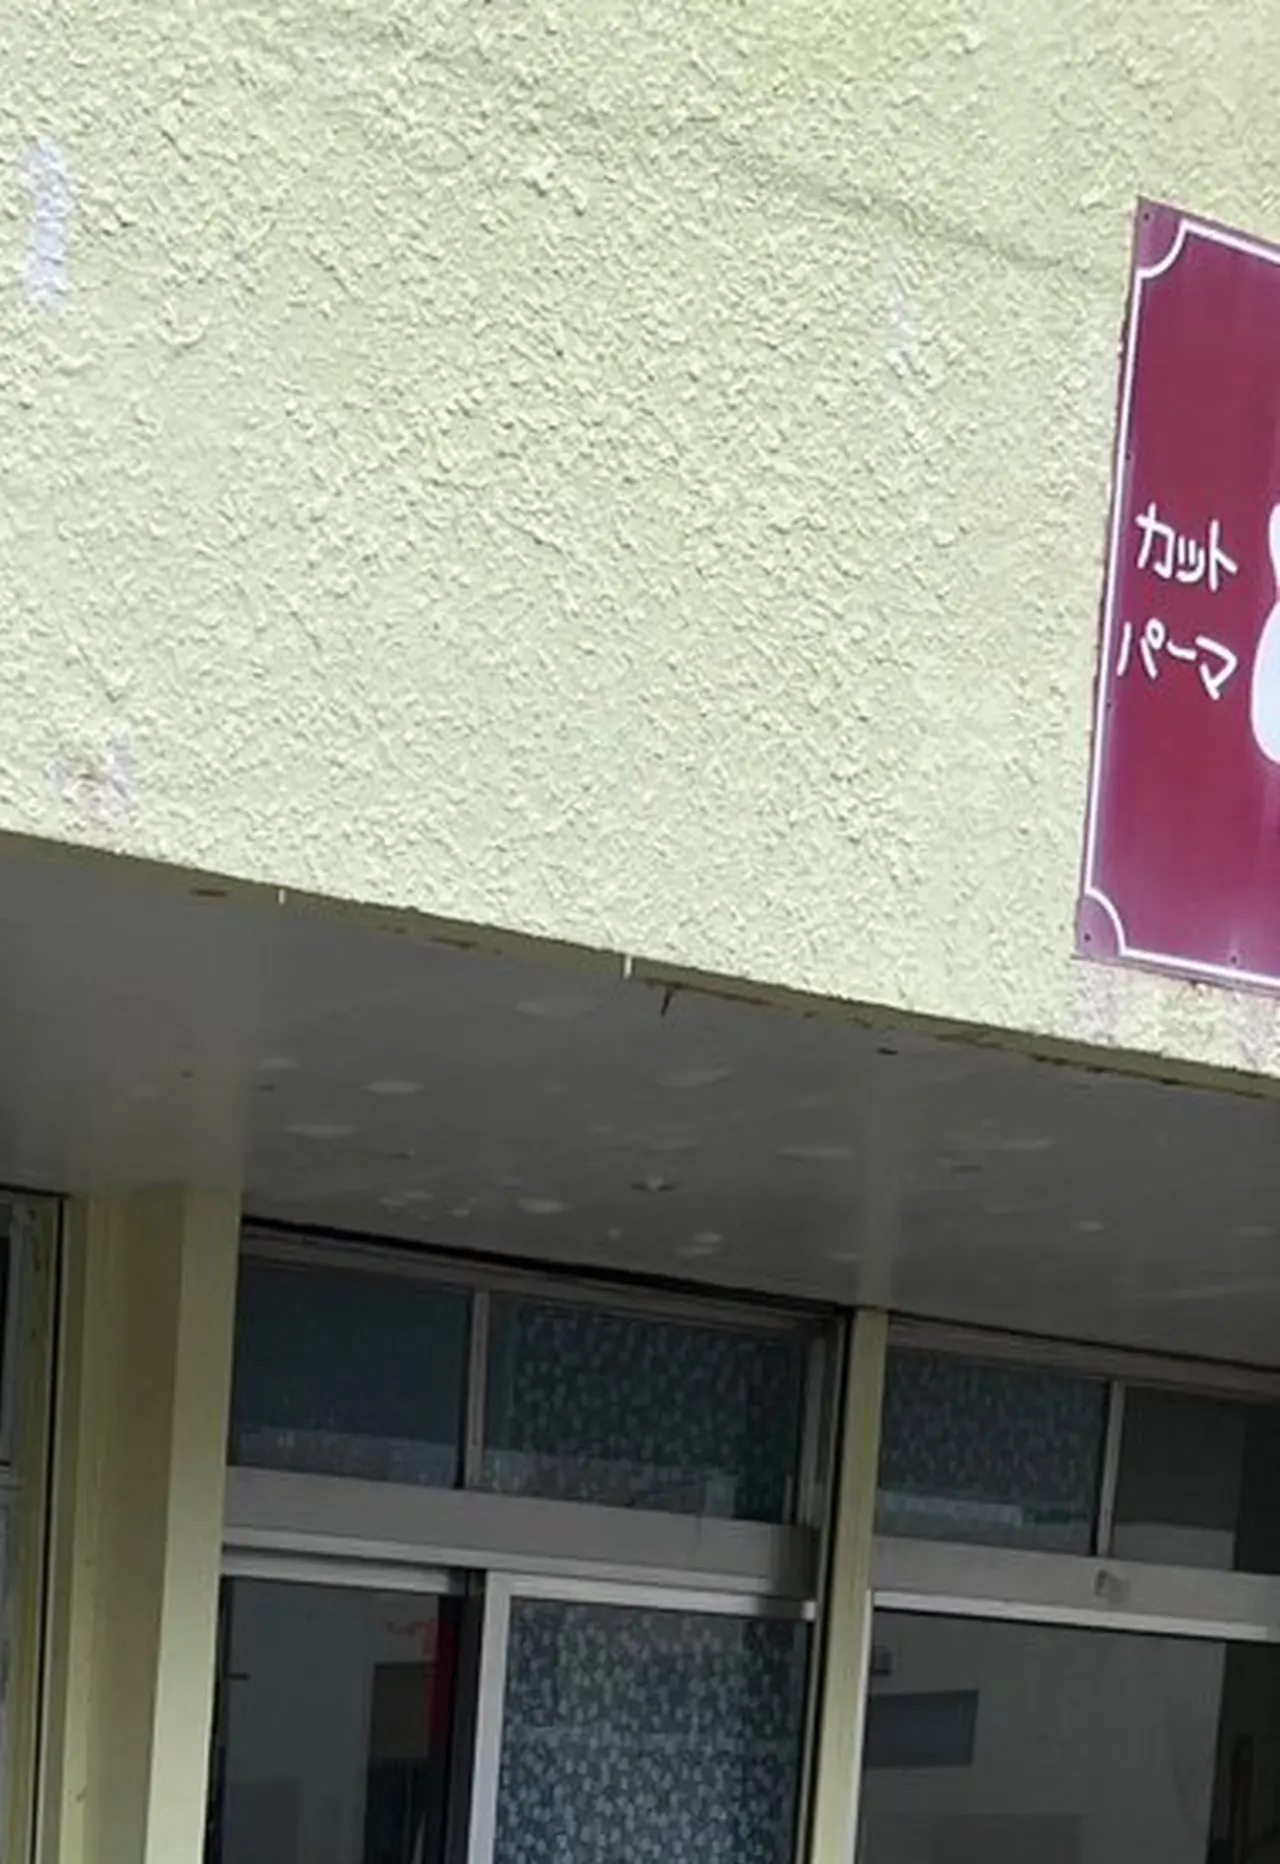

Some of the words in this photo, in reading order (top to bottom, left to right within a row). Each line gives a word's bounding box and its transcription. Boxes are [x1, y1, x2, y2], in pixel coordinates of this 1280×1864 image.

[1135, 502, 1237, 592] カット
[1116, 617, 1237, 701] パーマ
